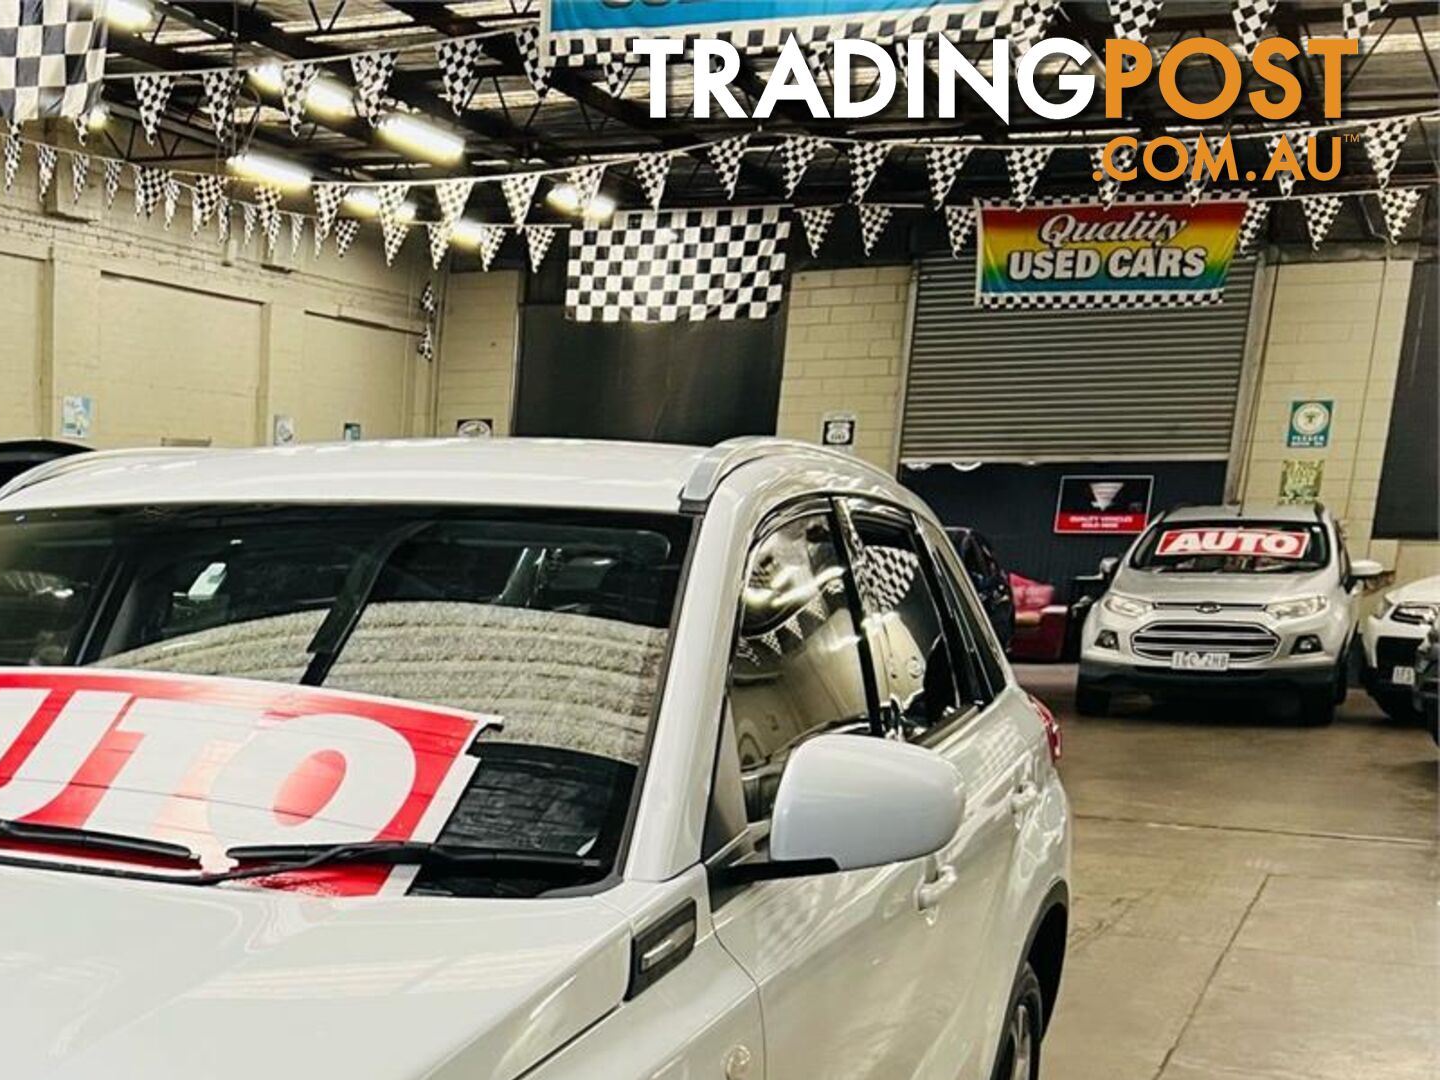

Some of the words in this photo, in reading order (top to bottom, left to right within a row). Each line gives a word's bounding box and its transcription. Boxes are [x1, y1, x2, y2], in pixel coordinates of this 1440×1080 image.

[1040, 211, 1187, 247] Quality
[1010, 249, 1101, 280] USED
[1109, 247, 1207, 278] CARS
[1164, 531, 1300, 554] AUTO
